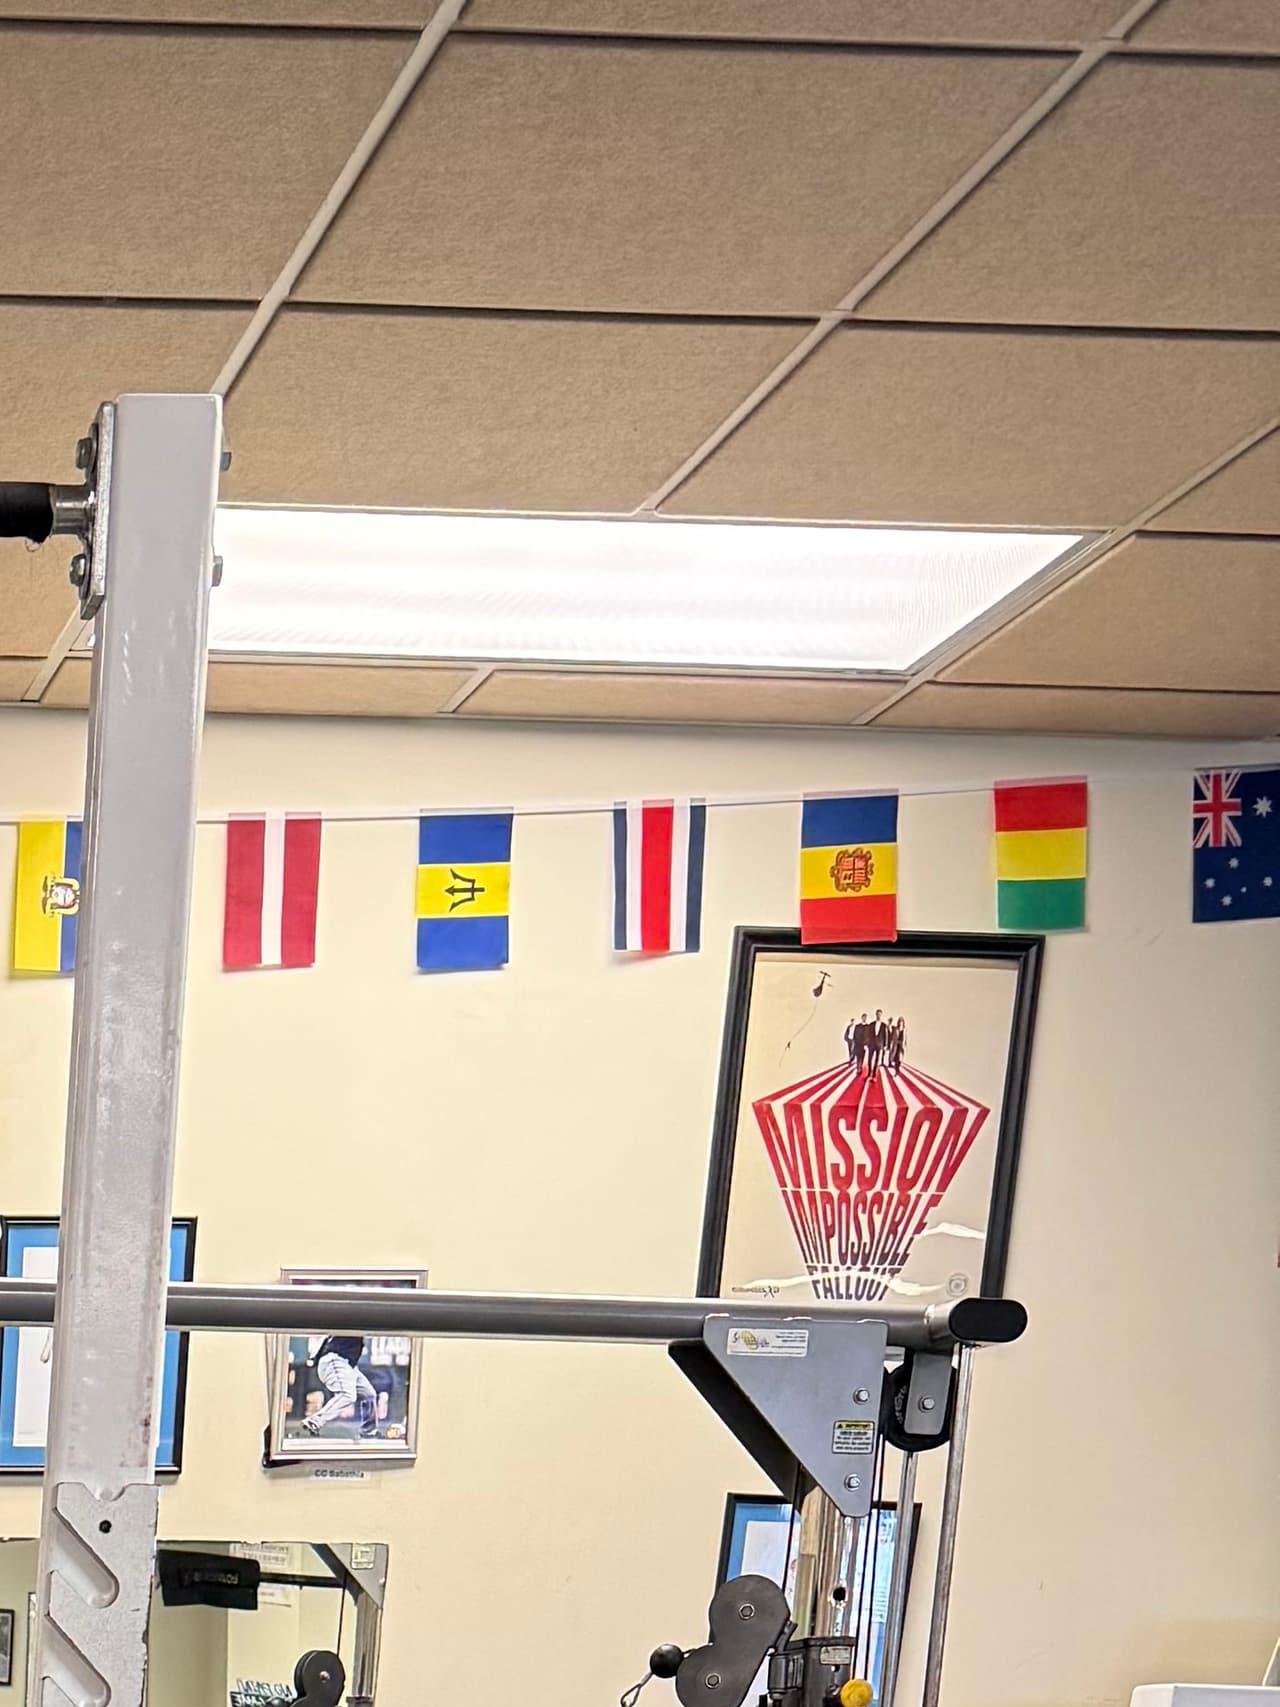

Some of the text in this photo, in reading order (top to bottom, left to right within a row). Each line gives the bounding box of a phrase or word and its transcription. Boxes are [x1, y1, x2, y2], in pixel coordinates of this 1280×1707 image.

[752, 1102, 990, 1193] MISSION
[781, 1190, 945, 1266] IMPOSSIBLE
[806, 1266, 903, 1301] FALLOUT
